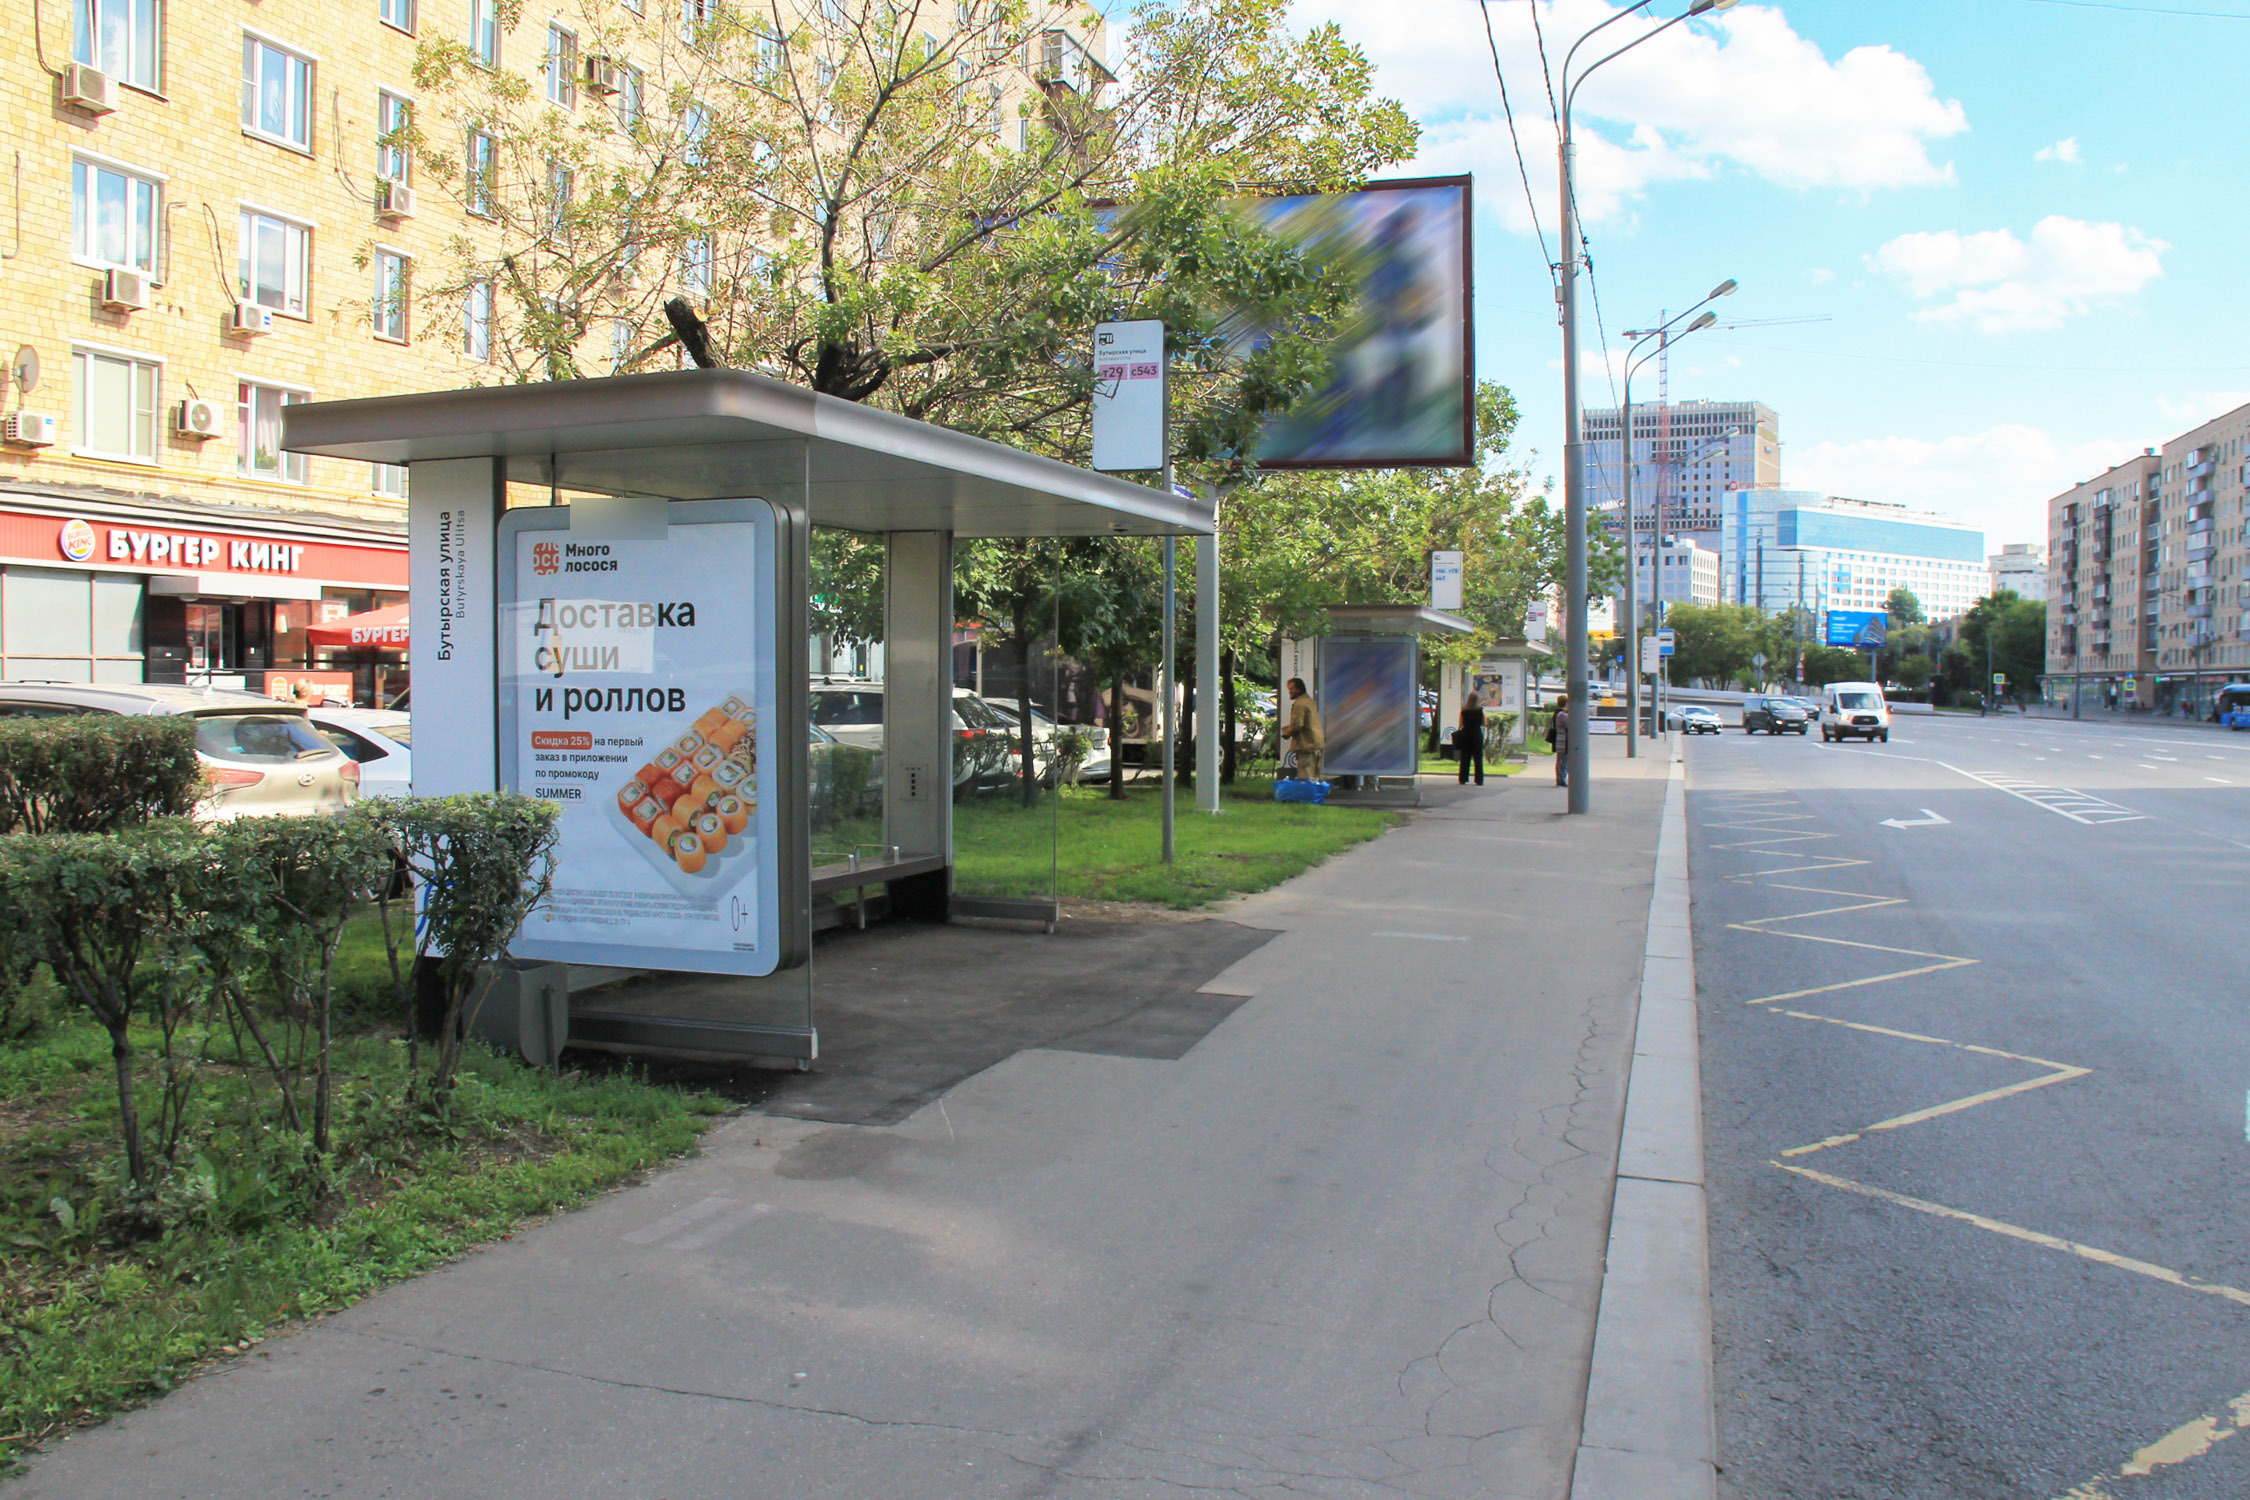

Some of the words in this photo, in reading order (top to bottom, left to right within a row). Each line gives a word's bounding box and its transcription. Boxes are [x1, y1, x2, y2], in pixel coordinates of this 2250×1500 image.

[1102, 366, 1124, 378] т29
[1131, 365, 1157, 376] с543
[440, 511, 453, 563] улица
[455, 510, 465, 547] Ulitsa
[109, 529, 220, 566] БУРГЕР
[230, 540, 304, 572] КИНГ
[565, 543, 610, 557] Много
[565, 559, 618, 573] лосося
[455, 550, 467, 619] Butyrskaya
[438, 567, 453, 661] Бутырская
[534, 598, 696, 636] Доставка
[351, 626, 409, 643] БУРГЕР
[535, 646, 620, 679] суши
[535, 688, 553, 712] и
[564, 687, 687, 720] роллов
[534, 735, 569, 747] Скидка
[570, 736, 591, 746] 25%
[594, 738, 606, 746] на
[607, 737, 644, 748] первый
[535, 753, 560, 762] заказ
[562, 754, 568, 762] в
[569, 753, 628, 764] приложении
[535, 769, 547, 778] по
[548, 770, 600, 780] промокоду
[535, 787, 582, 799] SUMMER
